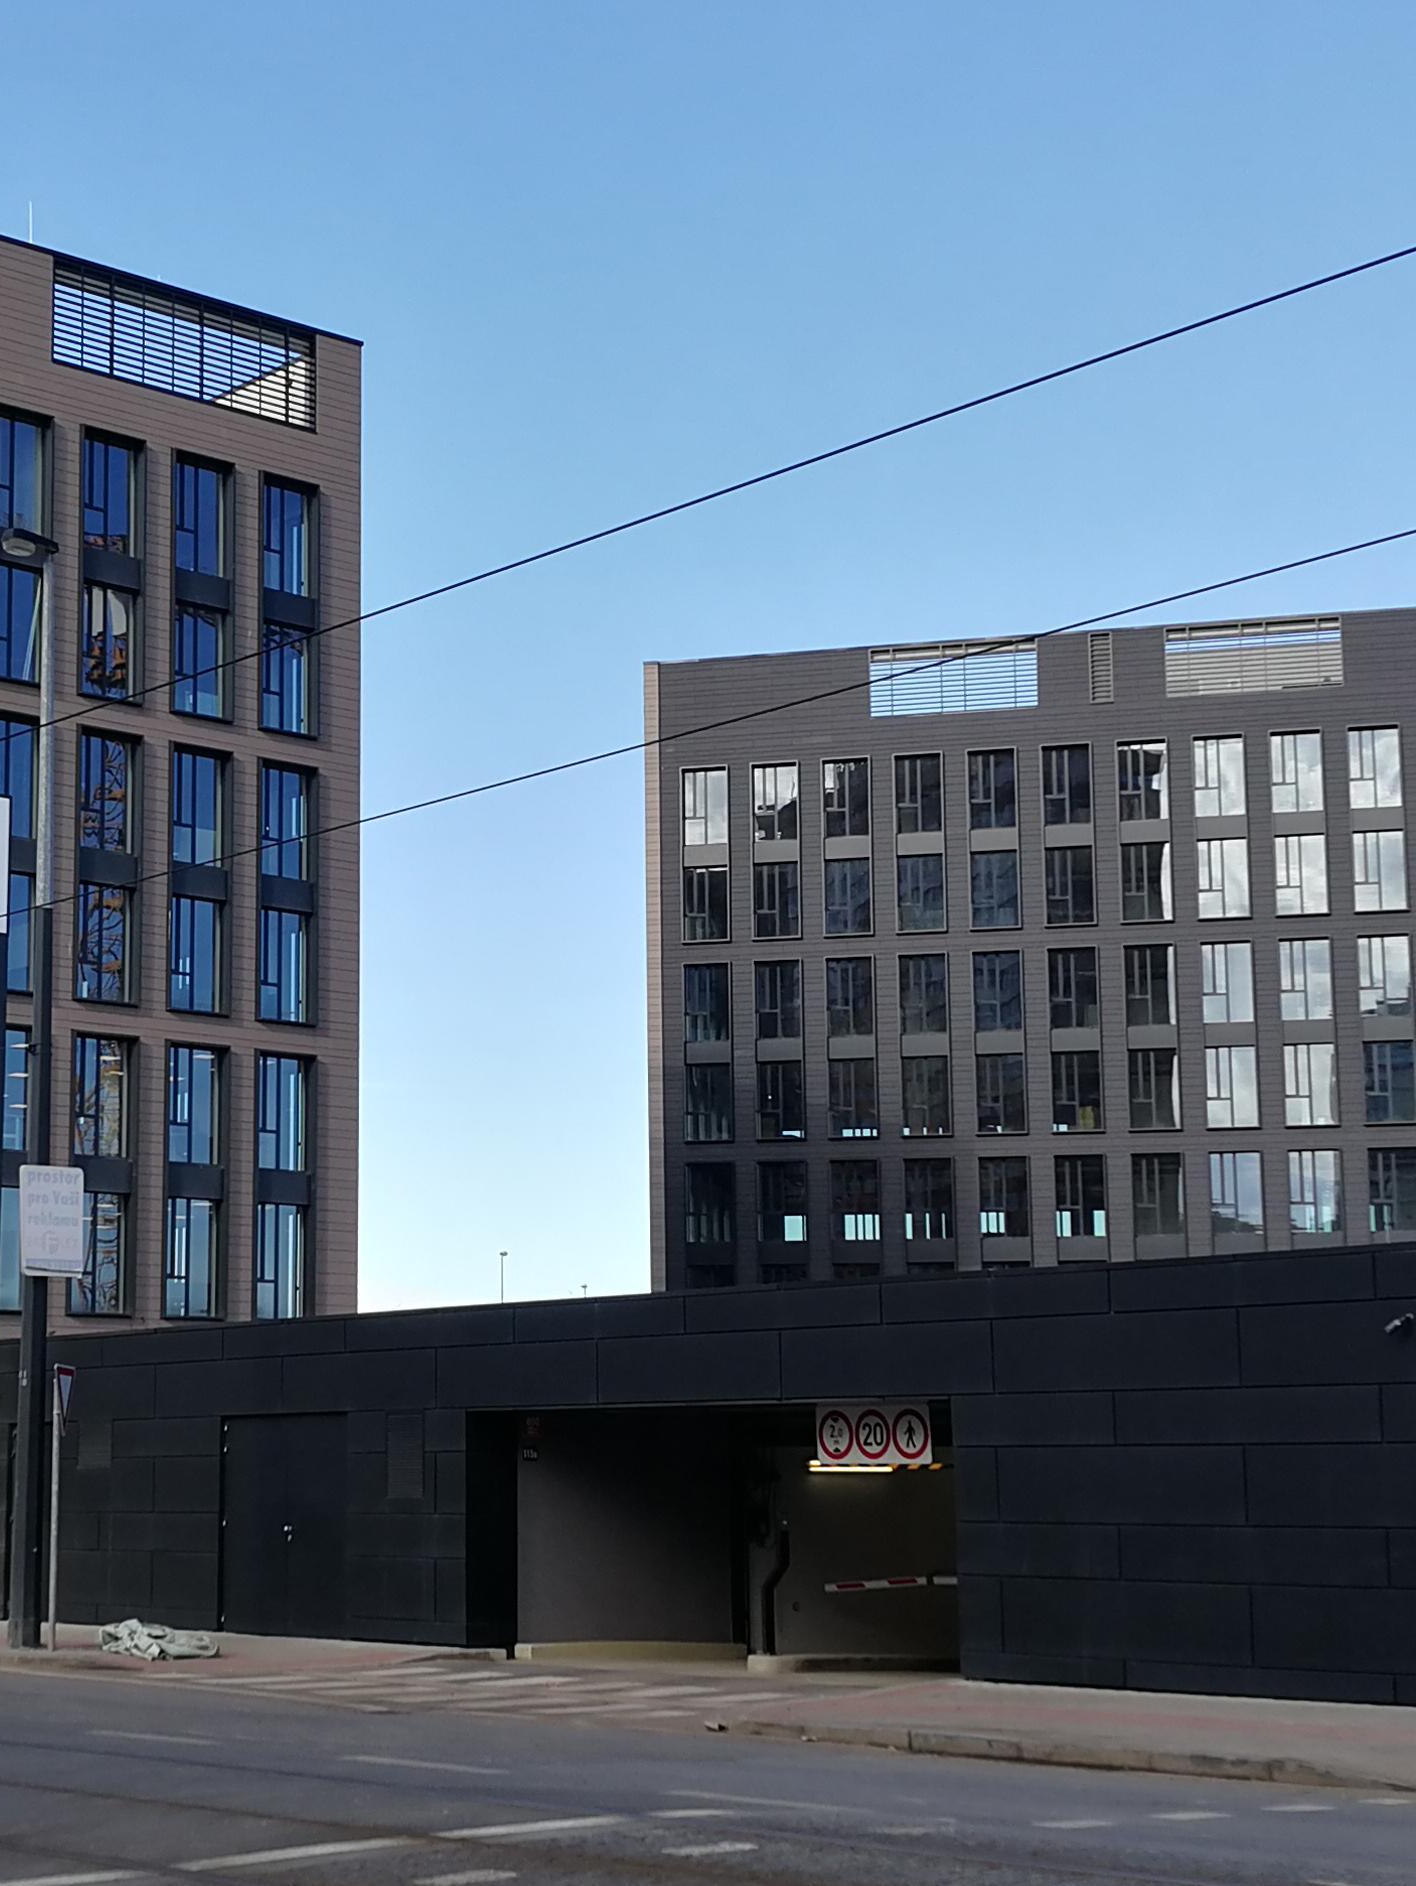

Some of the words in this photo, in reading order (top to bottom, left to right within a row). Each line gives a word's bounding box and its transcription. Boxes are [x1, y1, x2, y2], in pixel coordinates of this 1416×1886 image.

[27, 1170, 81, 1186] prostor
[27, 1193, 49, 1207] pro
[862, 1422, 884, 1446] 20
